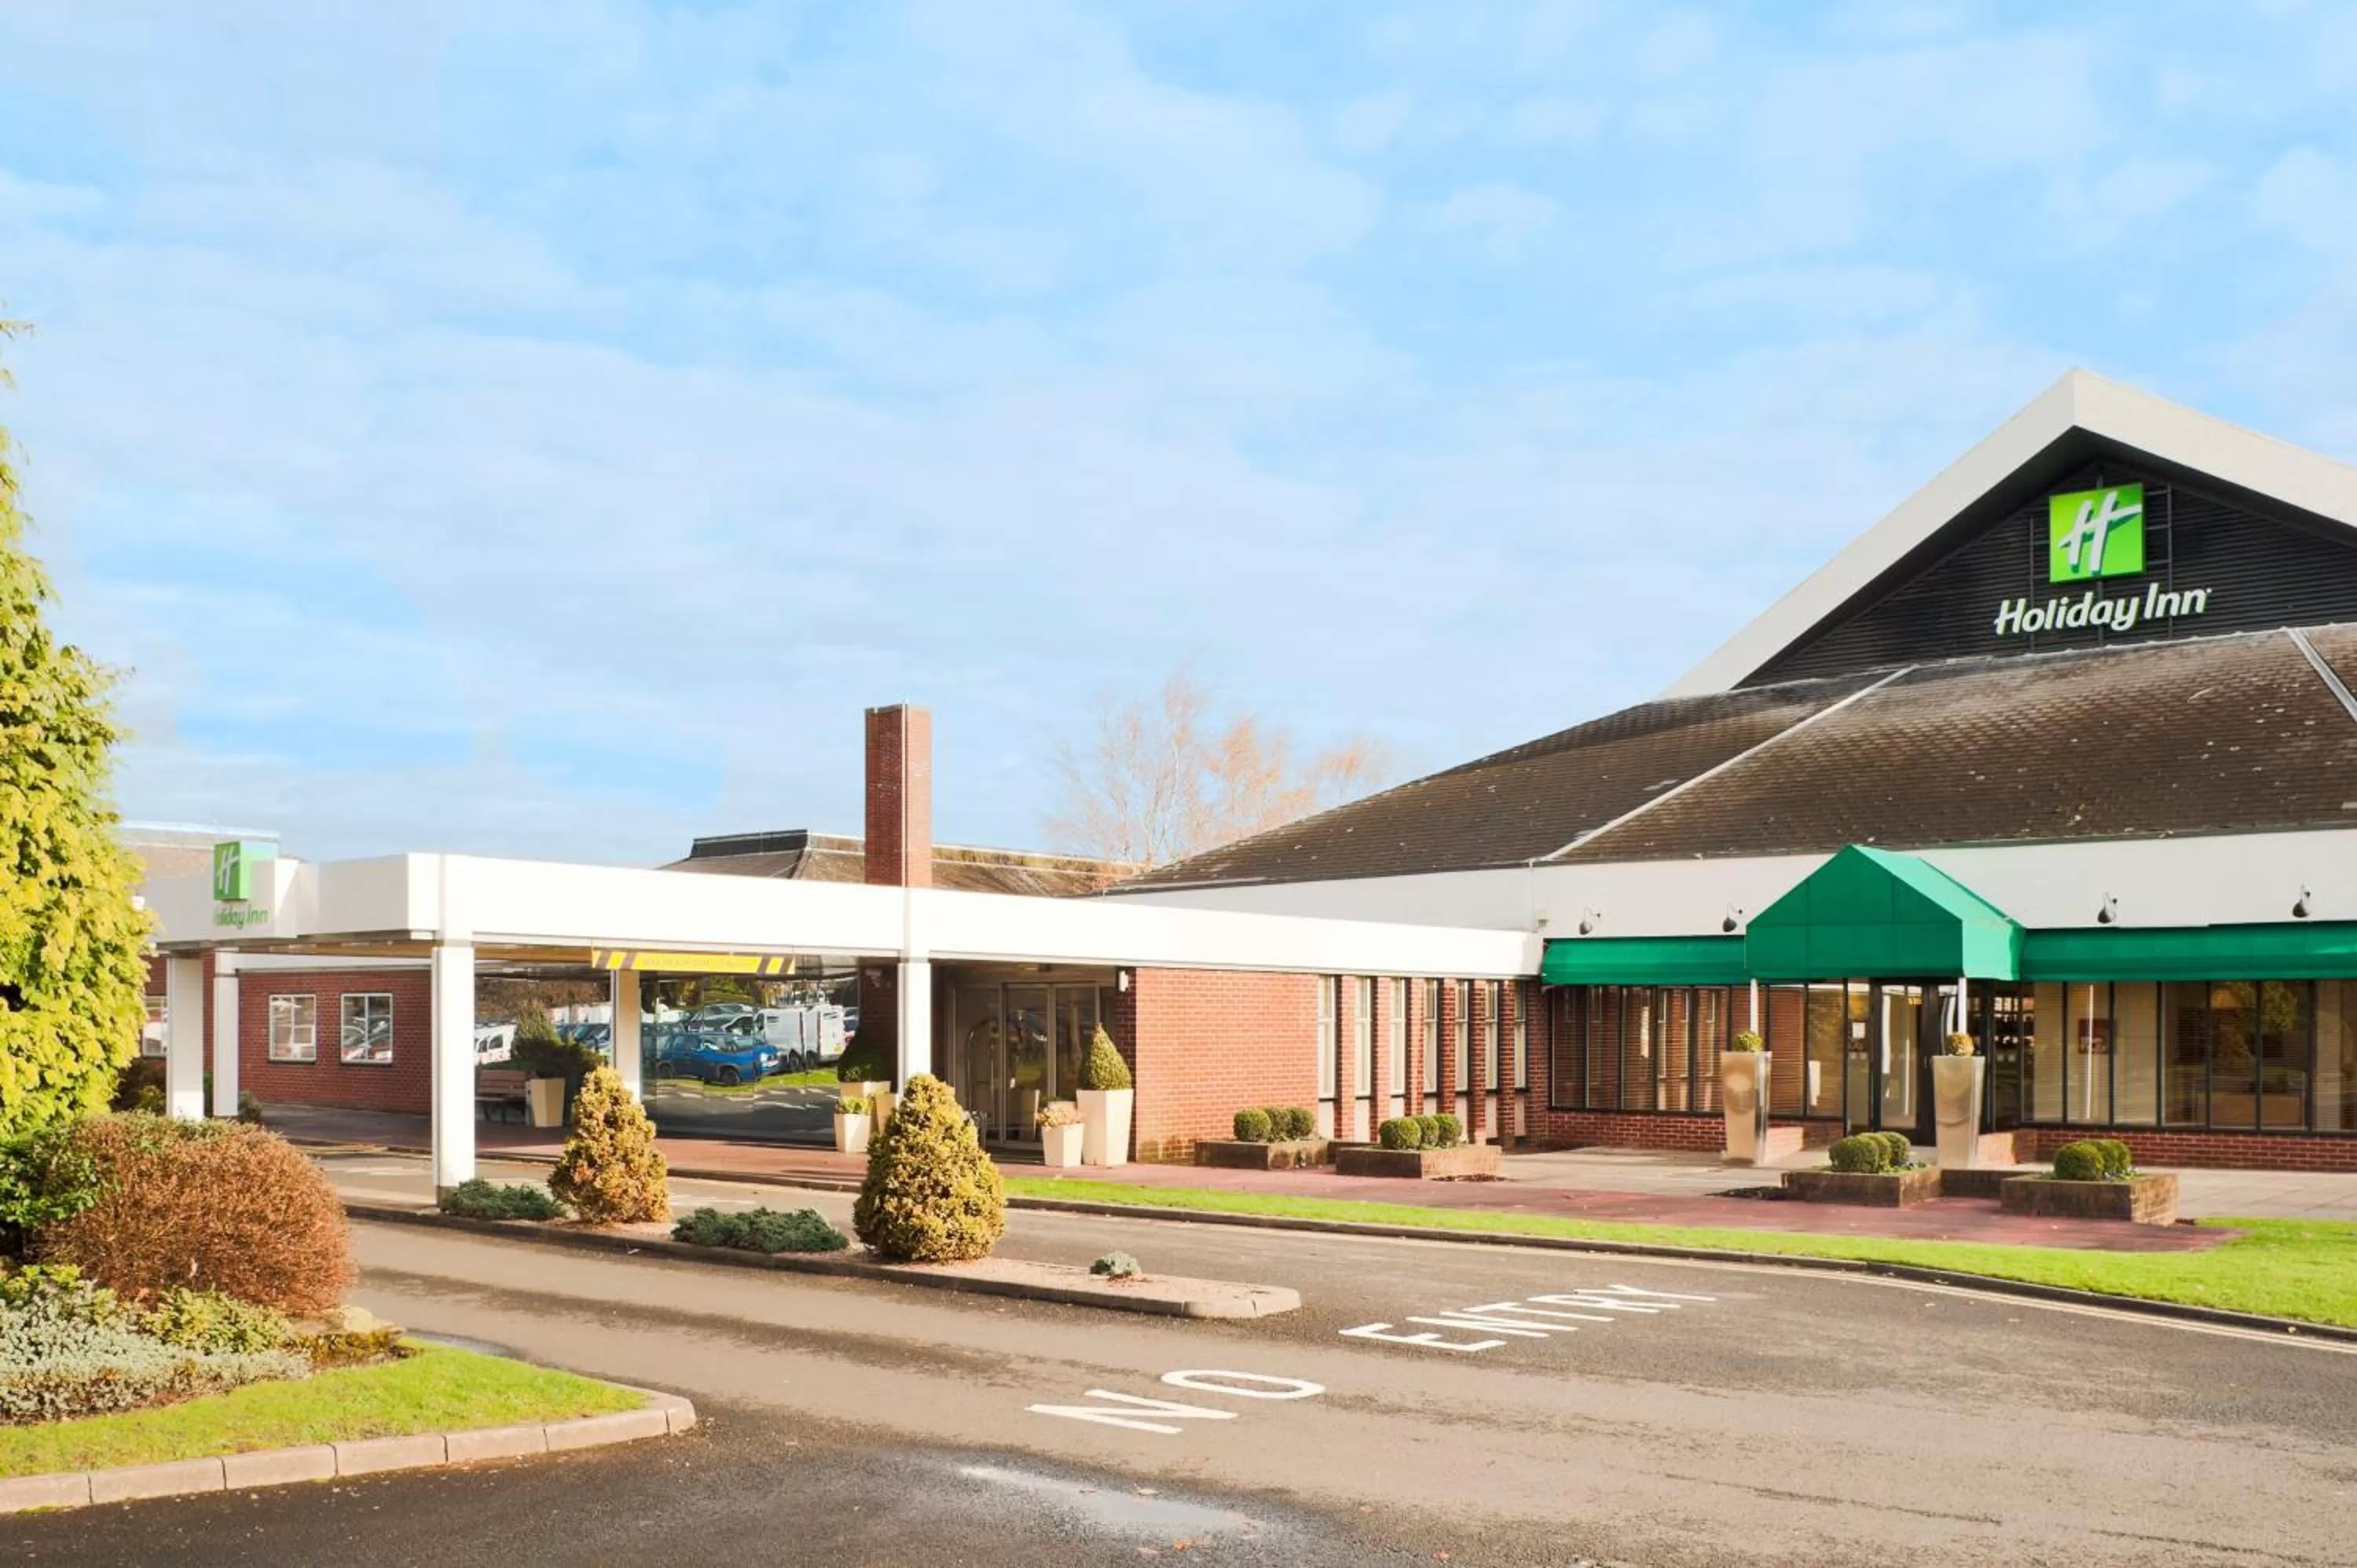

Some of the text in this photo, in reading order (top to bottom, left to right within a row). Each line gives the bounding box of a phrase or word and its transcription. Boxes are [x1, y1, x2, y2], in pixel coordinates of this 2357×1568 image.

[1993, 582, 2206, 636] Holiday Inn
[247, 903, 268, 924] Inn
[1338, 1284, 1717, 1352] ENTRY
[1025, 1369, 1326, 1434] NO
